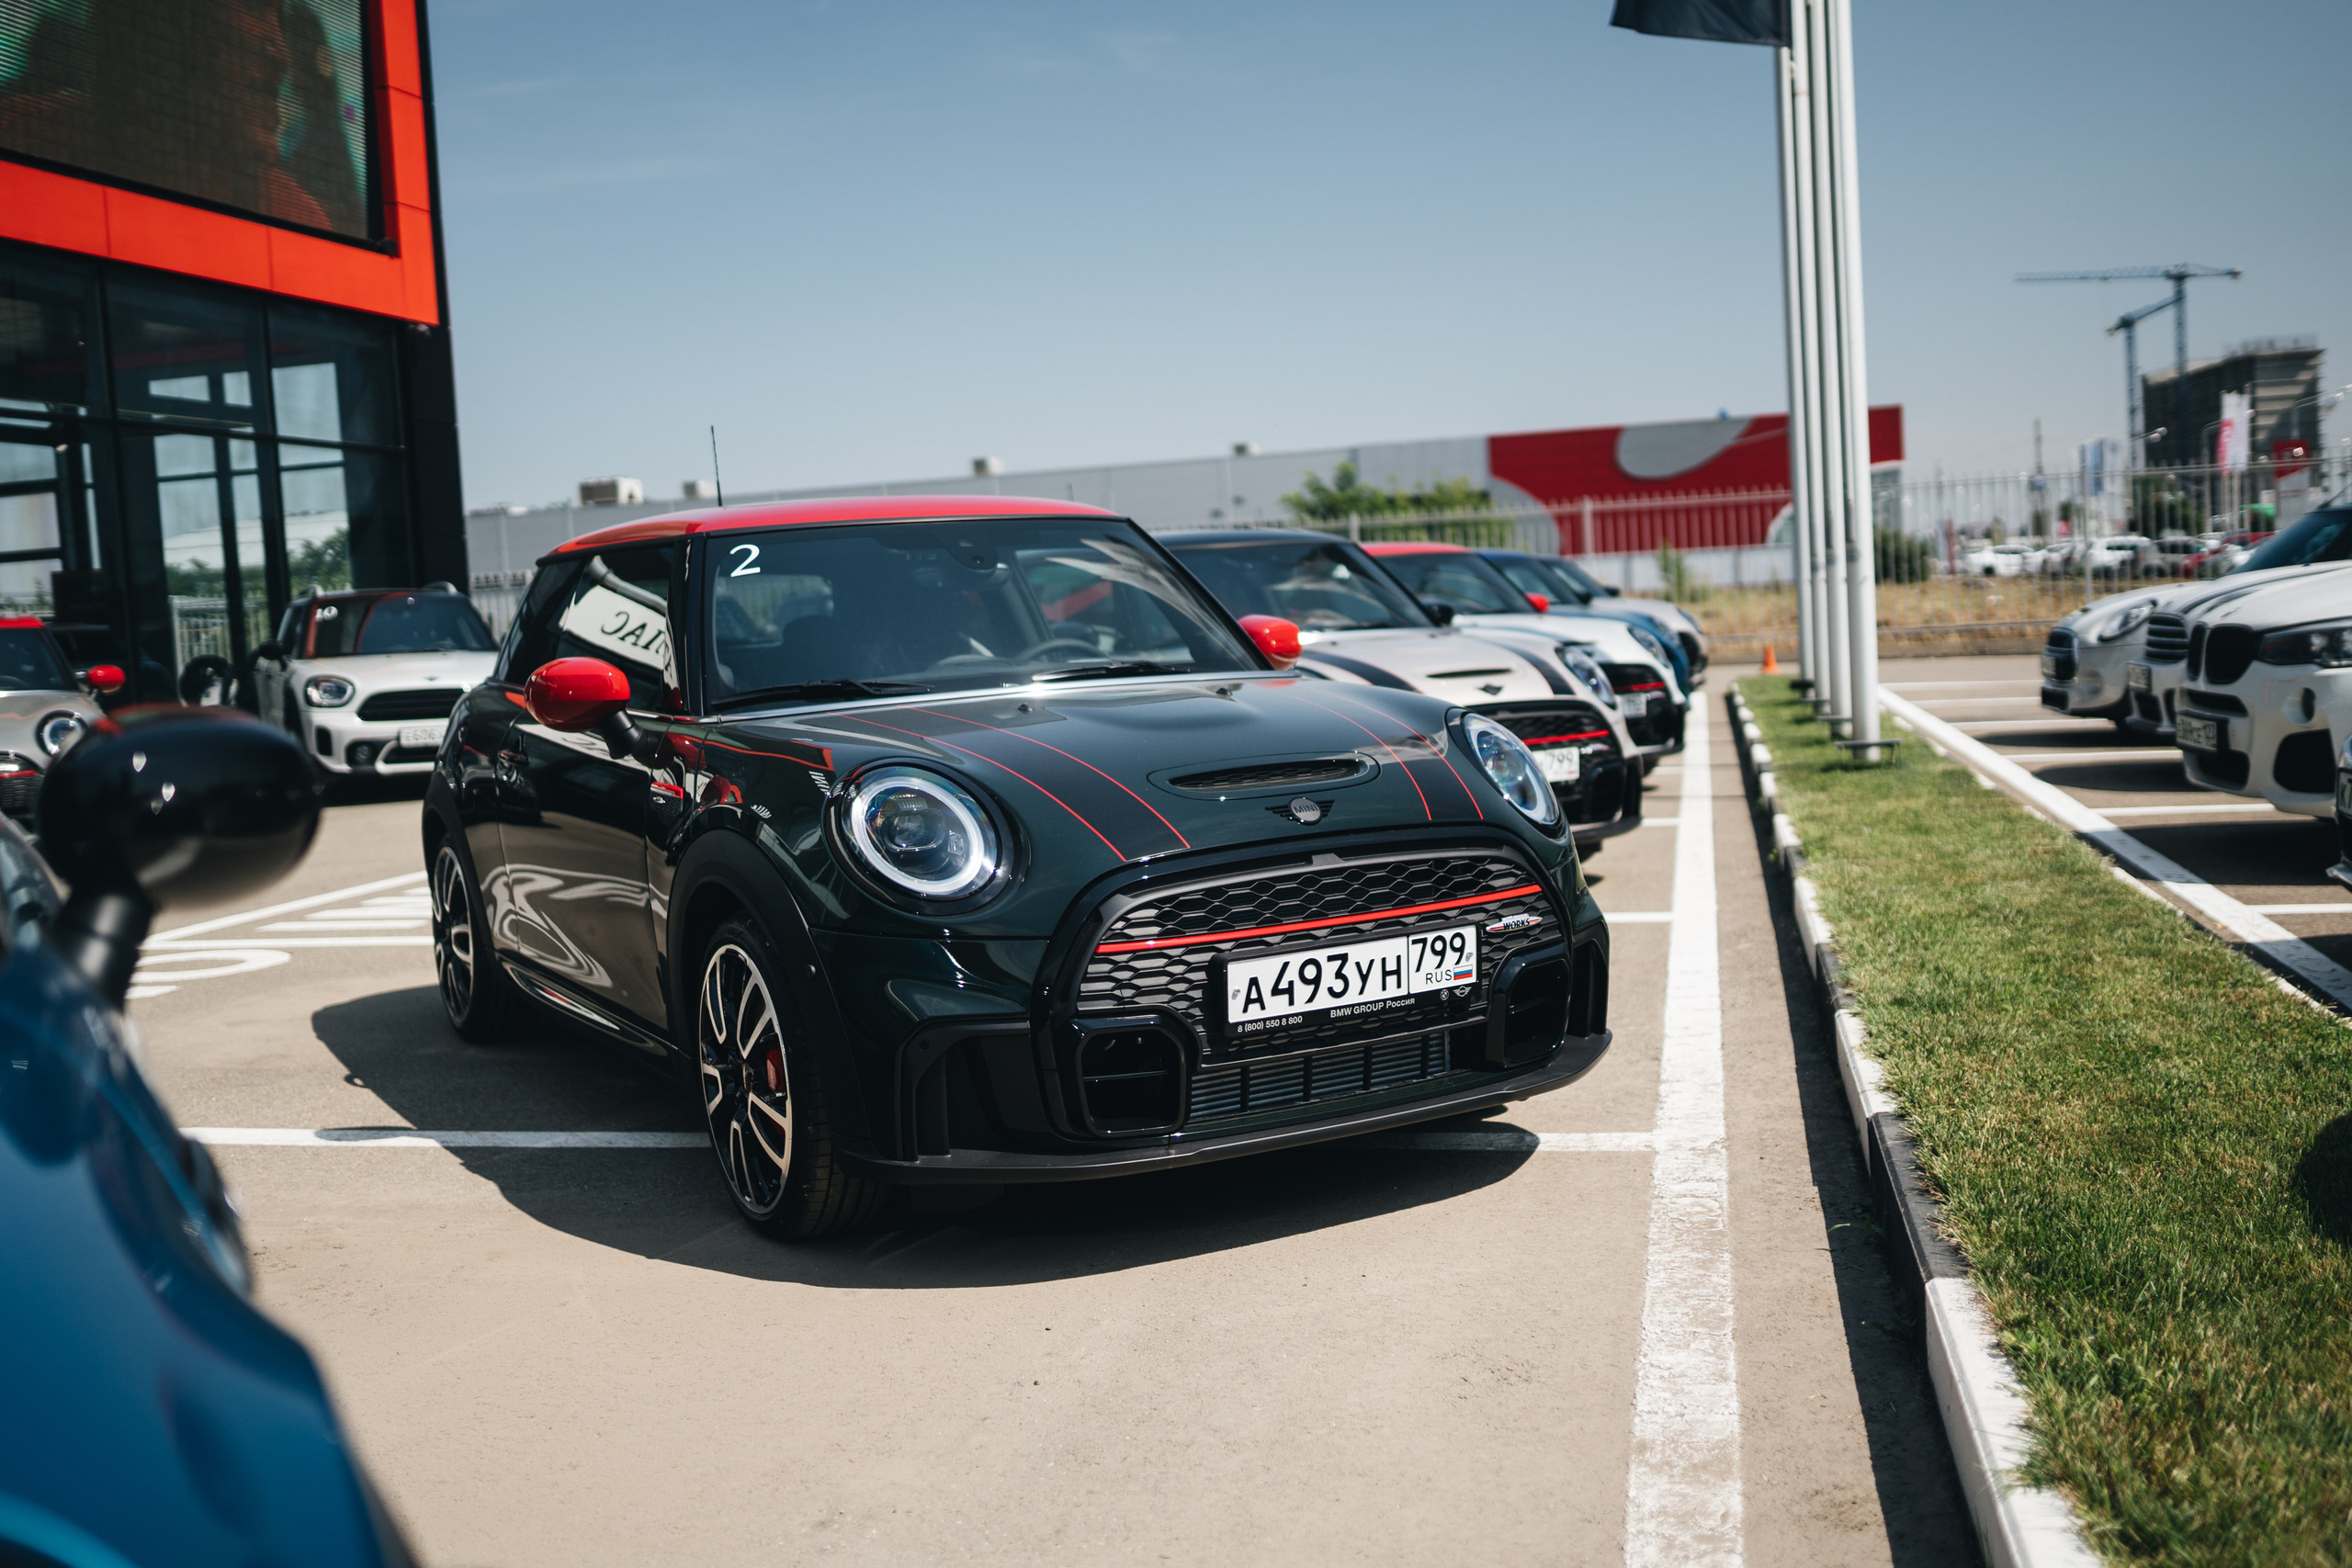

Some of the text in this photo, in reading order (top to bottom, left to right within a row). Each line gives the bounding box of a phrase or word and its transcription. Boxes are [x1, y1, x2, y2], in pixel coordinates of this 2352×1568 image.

[729, 544, 761, 578] 2
[1293, 804, 1318, 814] MINI
[1503, 919, 1531, 930] WORKS
[1411, 931, 1466, 974] 799
[1425, 969, 1453, 985] RUS
[1329, 998, 1416, 1019] BMW GROUP Россия
[1238, 1015, 1303, 1032] 8 (800) 550 8 800
